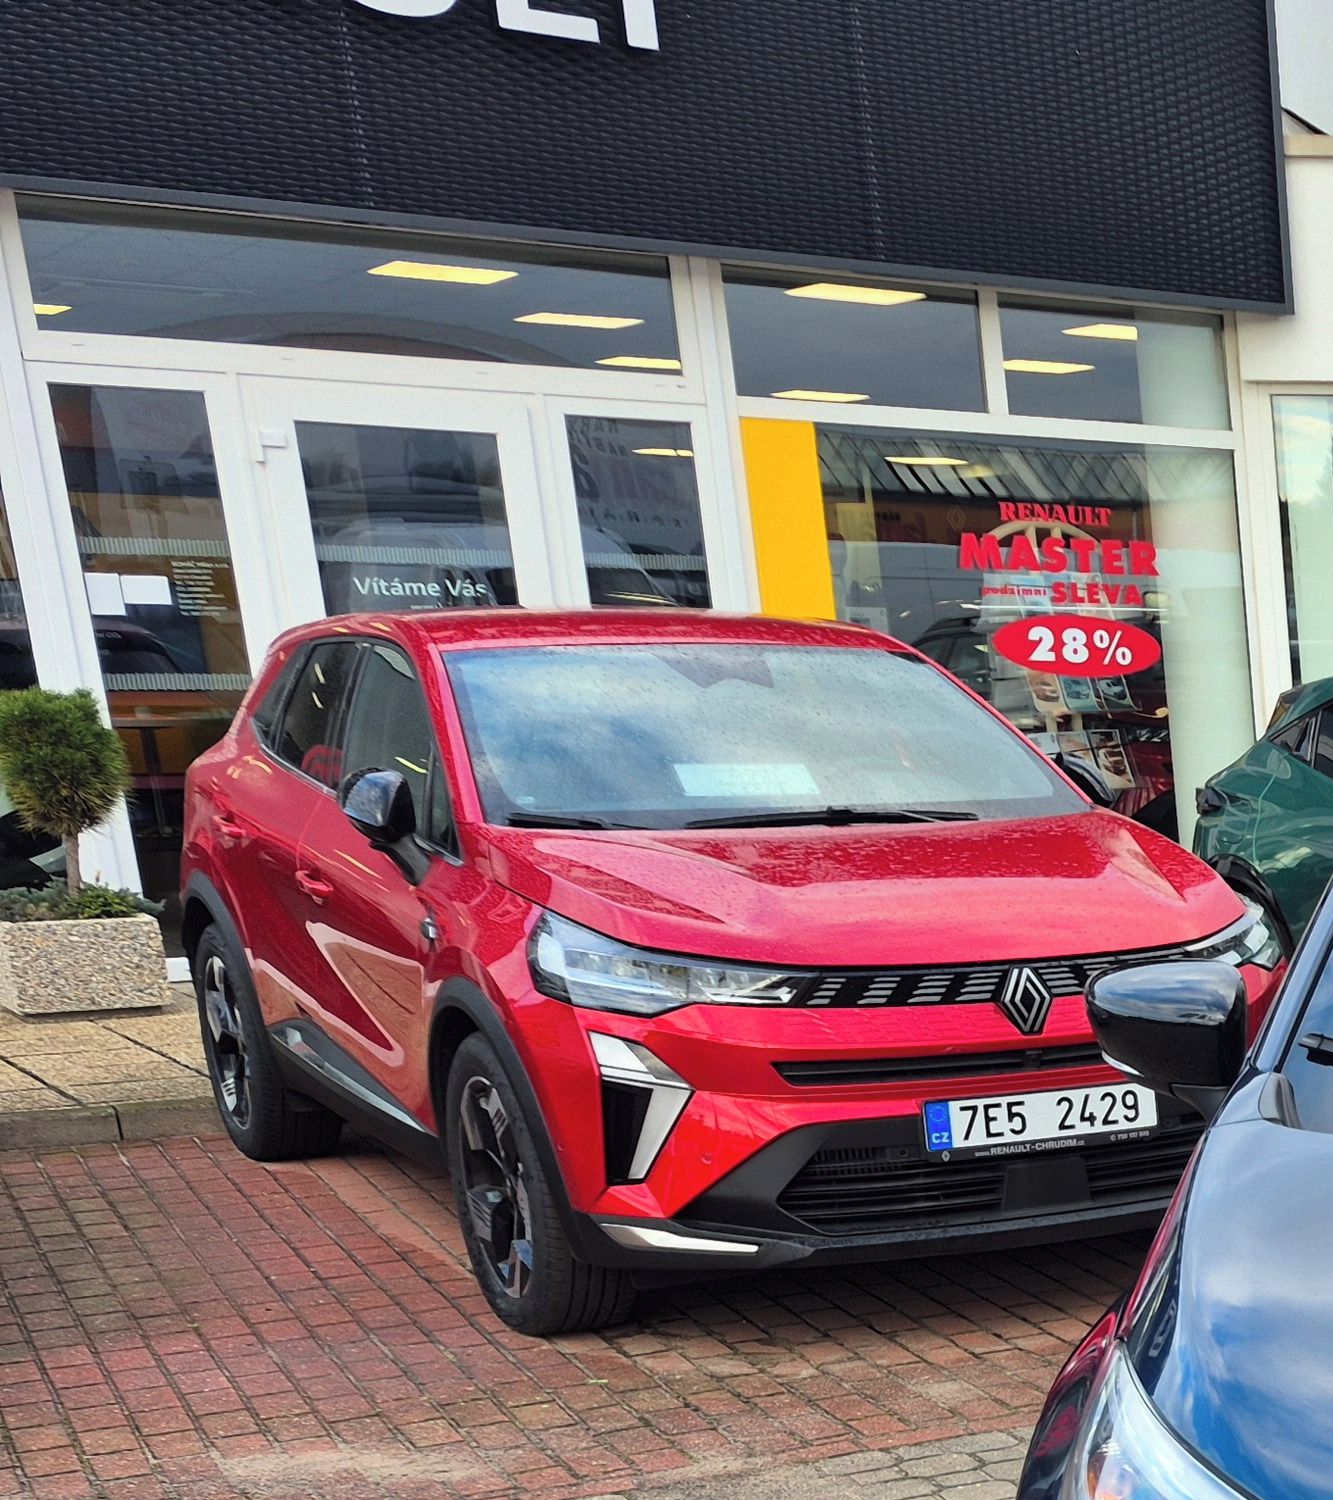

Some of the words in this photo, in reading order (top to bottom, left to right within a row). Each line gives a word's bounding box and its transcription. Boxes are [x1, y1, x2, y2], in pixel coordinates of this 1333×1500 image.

[999, 501, 1112, 527] RENAULT
[959, 532, 1160, 577] MASTER
[353, 576, 442, 597] Vítáme
[444, 578, 487, 598] Vás
[1051, 582, 1145, 606] SLEVA
[1027, 626, 1133, 666] 28%
[931, 1132, 949, 1144] CZ
[959, 1100, 1027, 1141] 7E5
[1056, 1090, 1140, 1131] 2429
